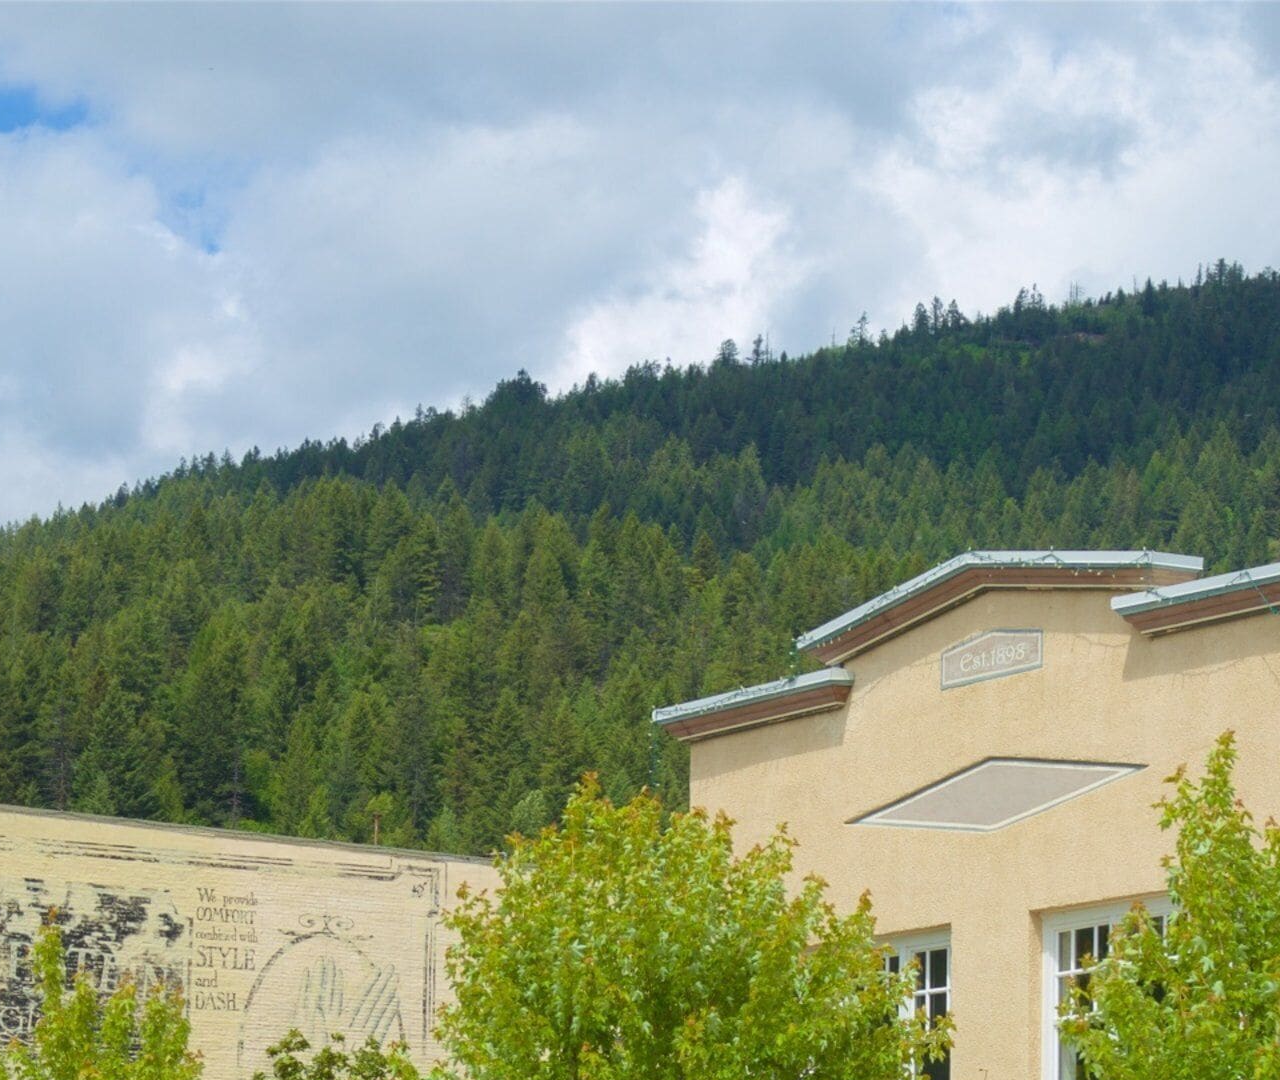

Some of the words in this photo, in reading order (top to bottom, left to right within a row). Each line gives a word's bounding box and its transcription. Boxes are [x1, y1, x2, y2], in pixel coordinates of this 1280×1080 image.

[196, 886, 216, 903] We
[196, 906, 257, 925] COMFORT
[196, 945, 256, 971] STYLE
[195, 970, 217, 988] and
[195, 991, 239, 1012] DASH
